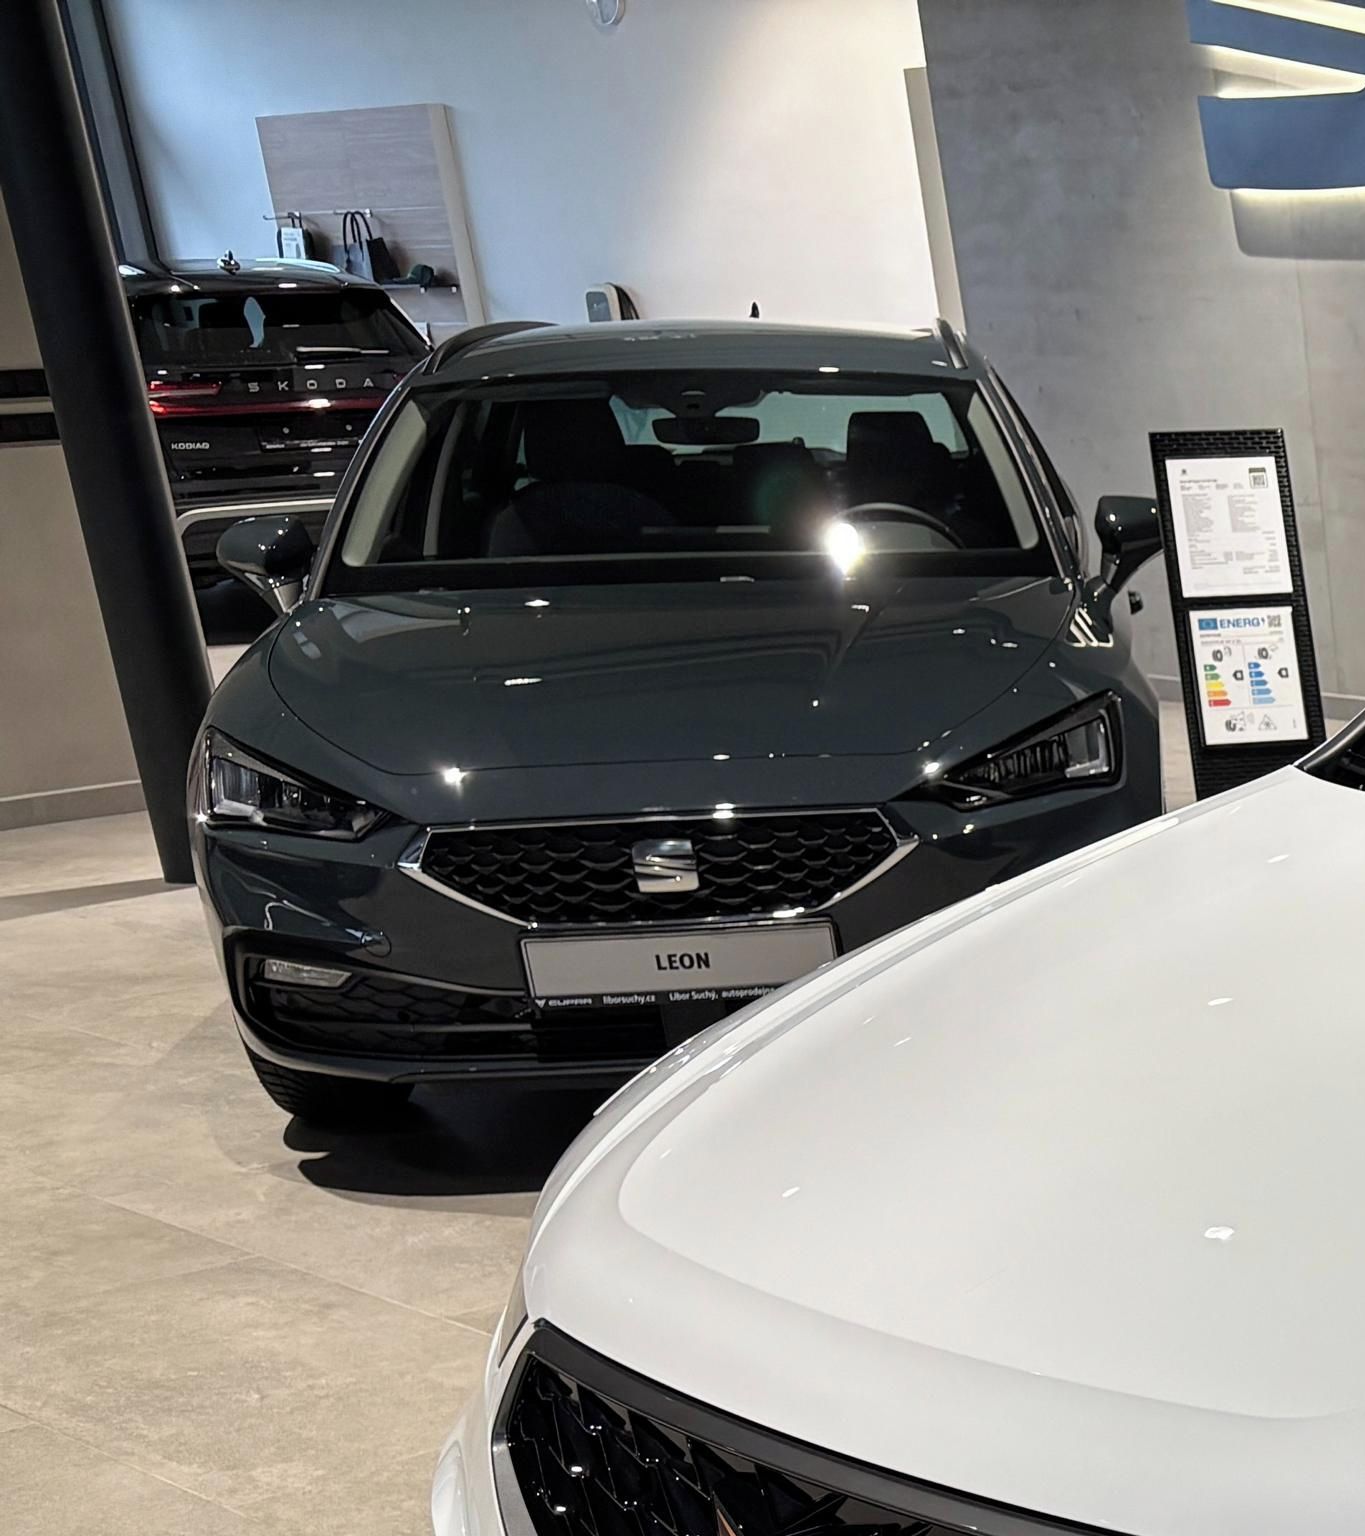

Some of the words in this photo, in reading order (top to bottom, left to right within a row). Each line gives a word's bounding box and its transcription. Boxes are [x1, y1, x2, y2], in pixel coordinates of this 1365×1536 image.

[1219, 617, 1260, 629] ENERG
[655, 952, 711, 971] LEON
[602, 994, 656, 1006] liborsuchy.cz
